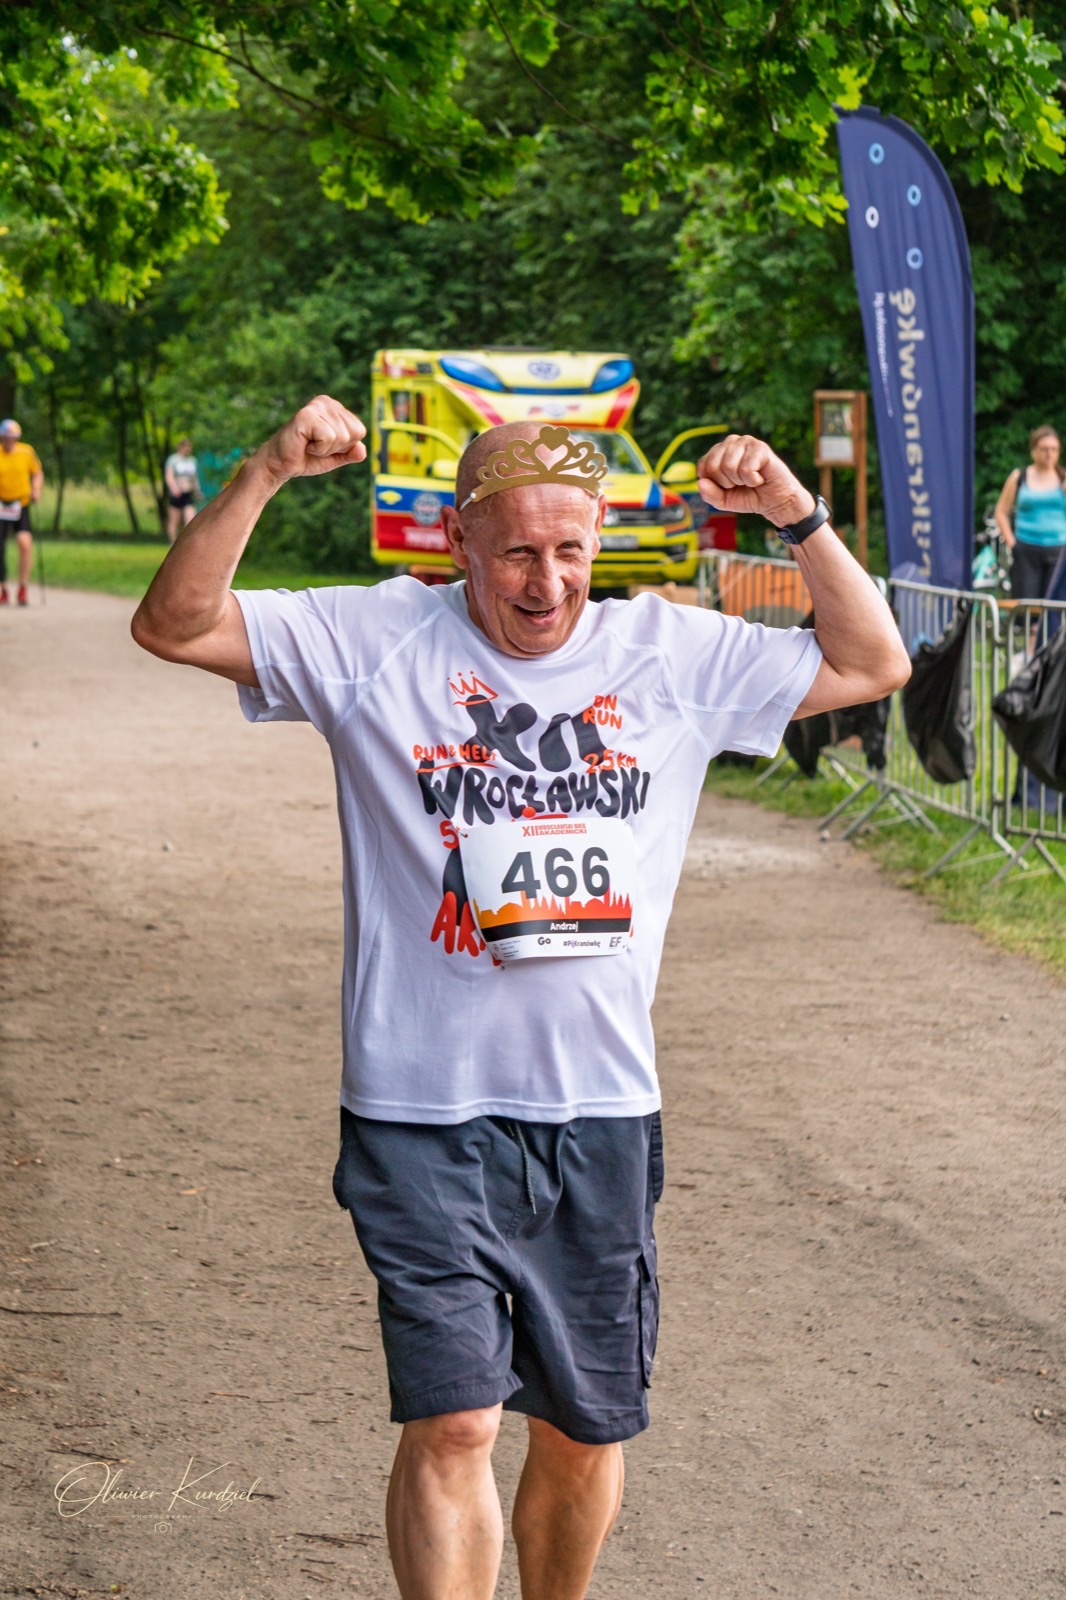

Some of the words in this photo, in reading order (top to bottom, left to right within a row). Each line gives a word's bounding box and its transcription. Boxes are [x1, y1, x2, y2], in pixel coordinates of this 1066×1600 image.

[582, 707, 623, 730] RUN
[418, 757, 650, 826] WROCŁAWSKI
[522, 825, 539, 837] XII
[501, 846, 611, 900] 466
[550, 922, 579, 932] Andrzej
